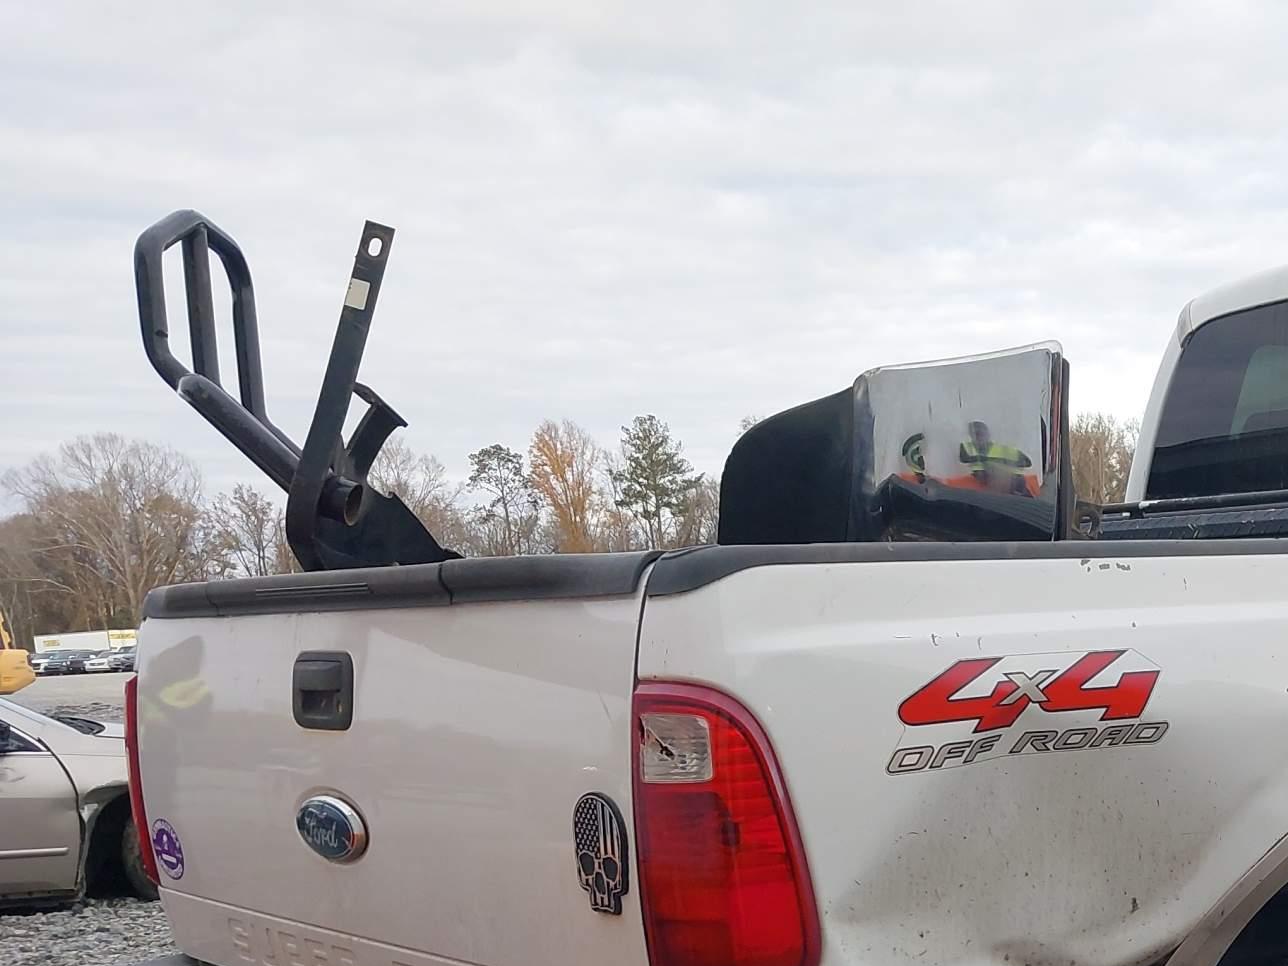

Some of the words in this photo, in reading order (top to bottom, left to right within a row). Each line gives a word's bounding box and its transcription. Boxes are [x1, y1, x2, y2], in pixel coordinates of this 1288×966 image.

[885, 733, 1004, 774] OFF
[1009, 721, 1170, 755] ROAD
[303, 808, 339, 848] Ford
